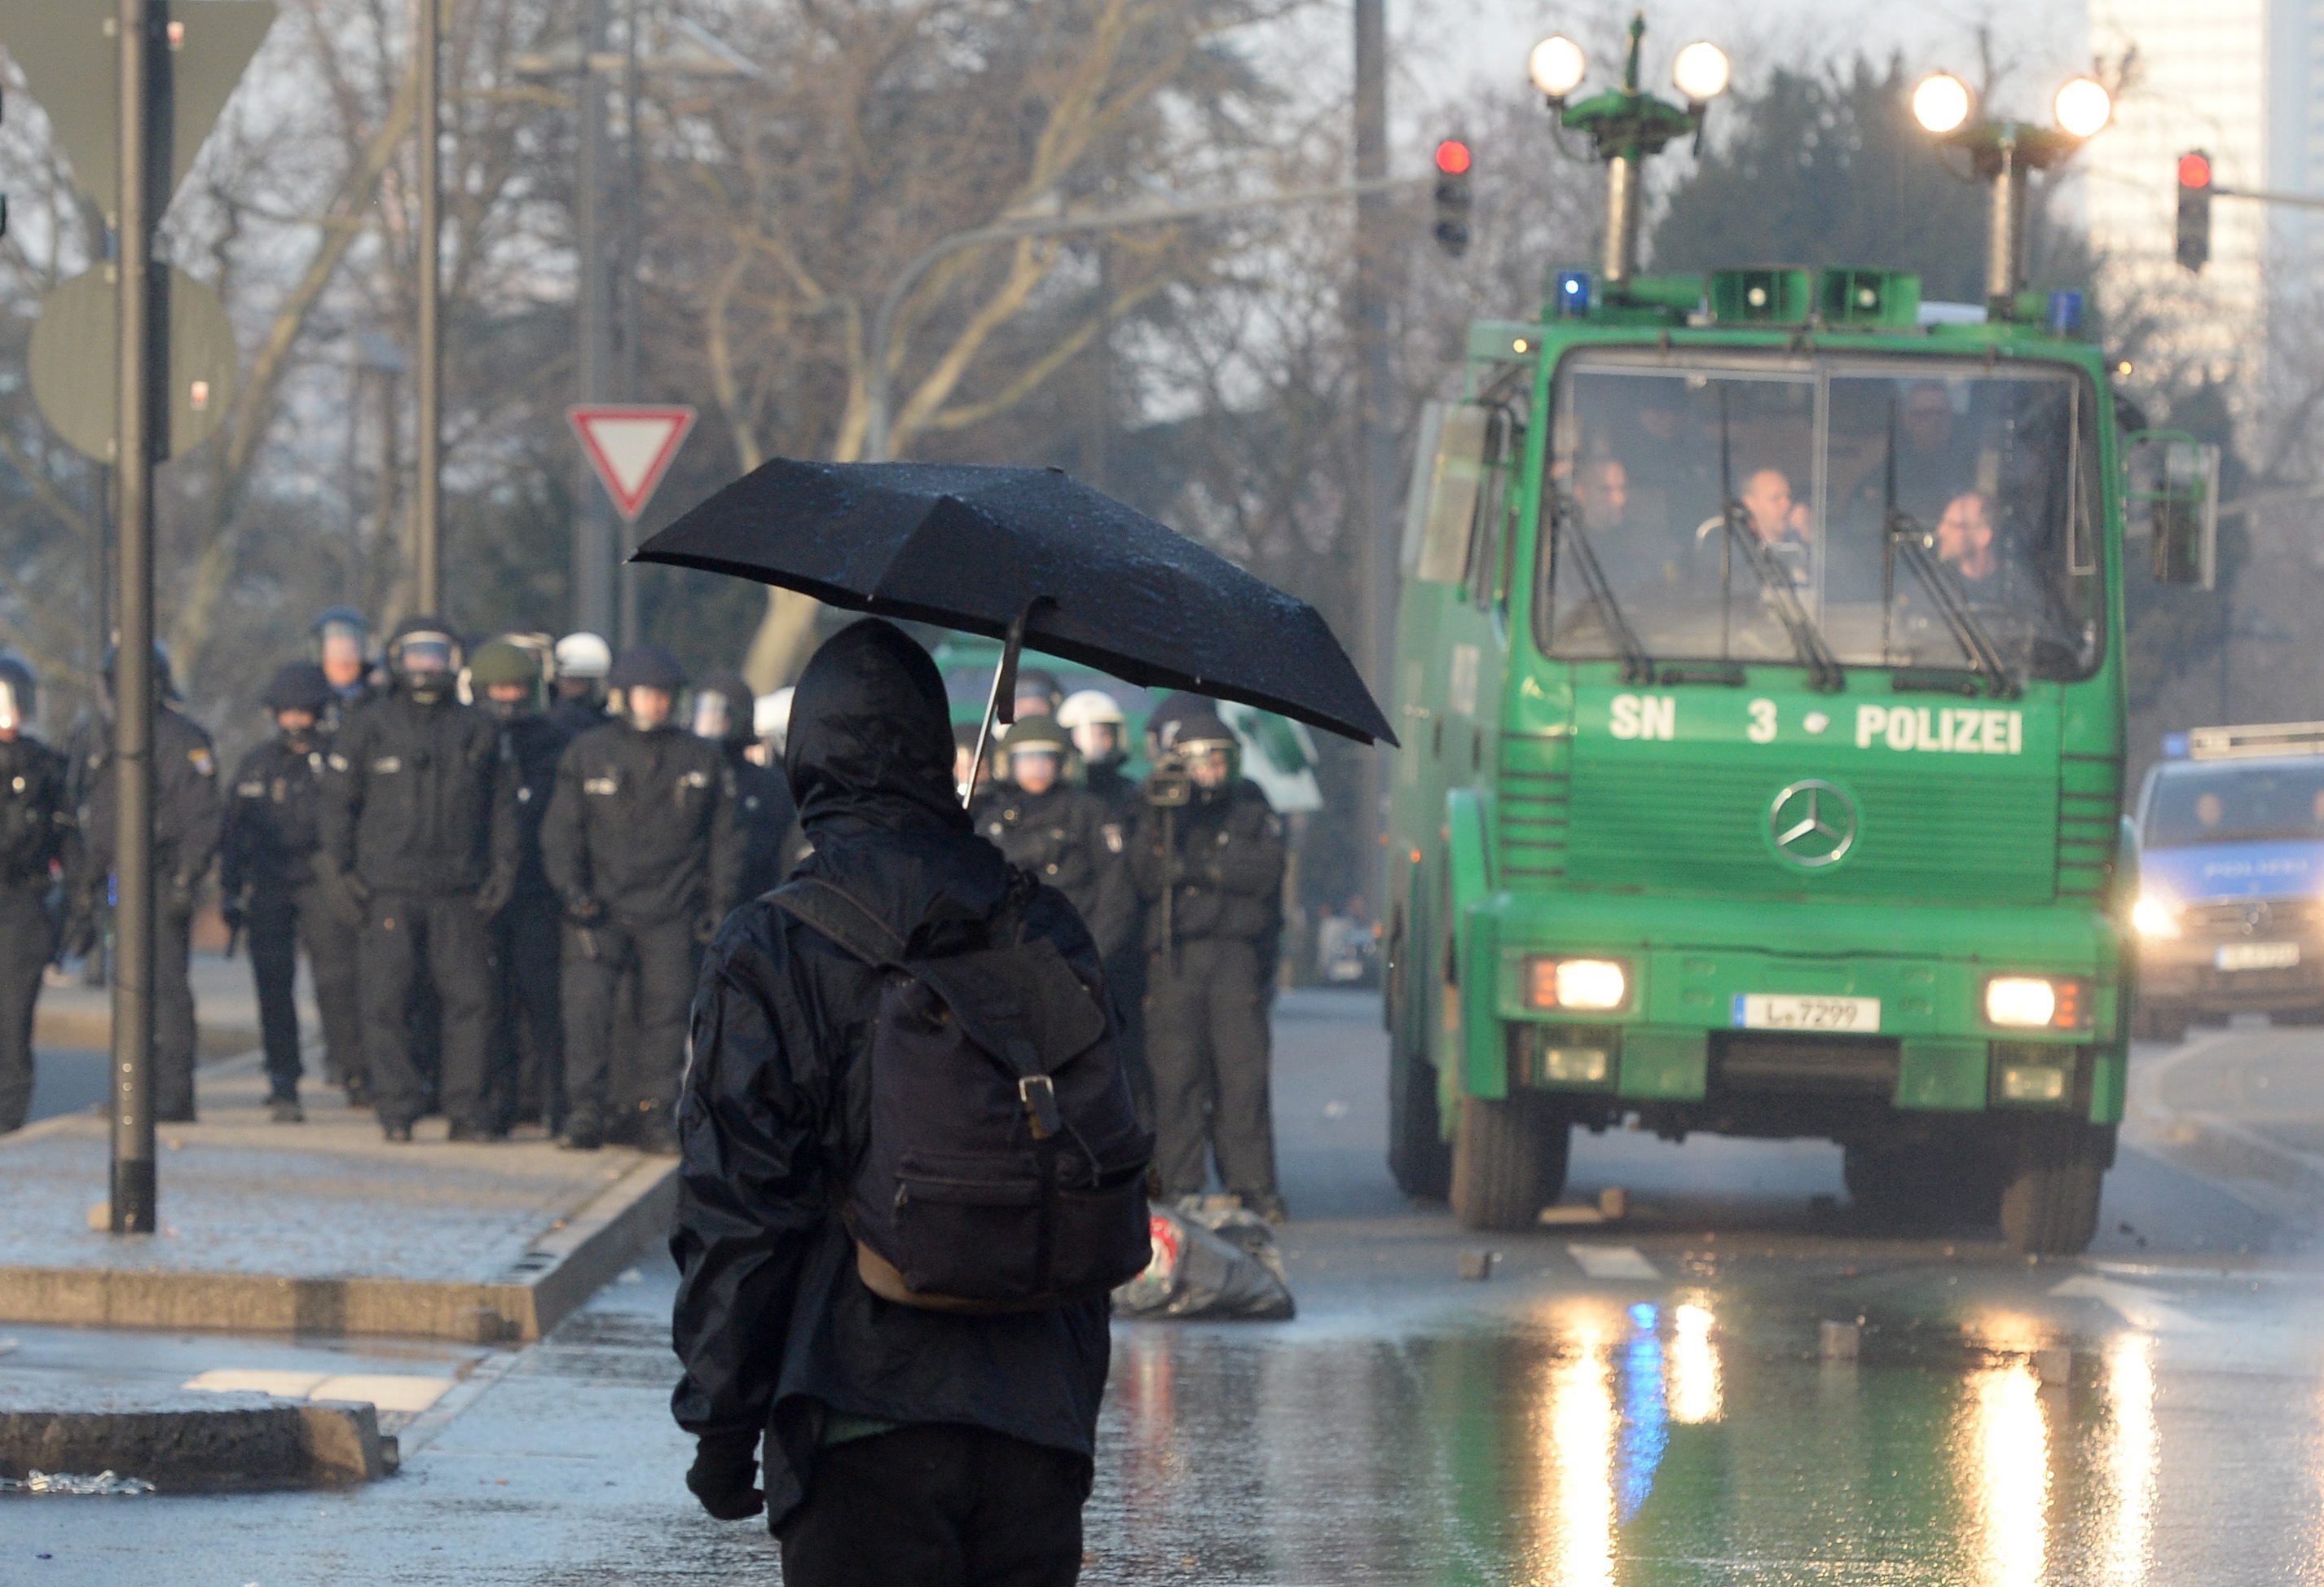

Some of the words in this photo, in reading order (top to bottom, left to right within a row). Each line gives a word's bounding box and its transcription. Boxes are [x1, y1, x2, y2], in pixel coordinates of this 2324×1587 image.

[1609, 694, 1675, 741] SN
[1747, 698, 1777, 744] 3
[1855, 704, 2022, 754] POLIZEI
